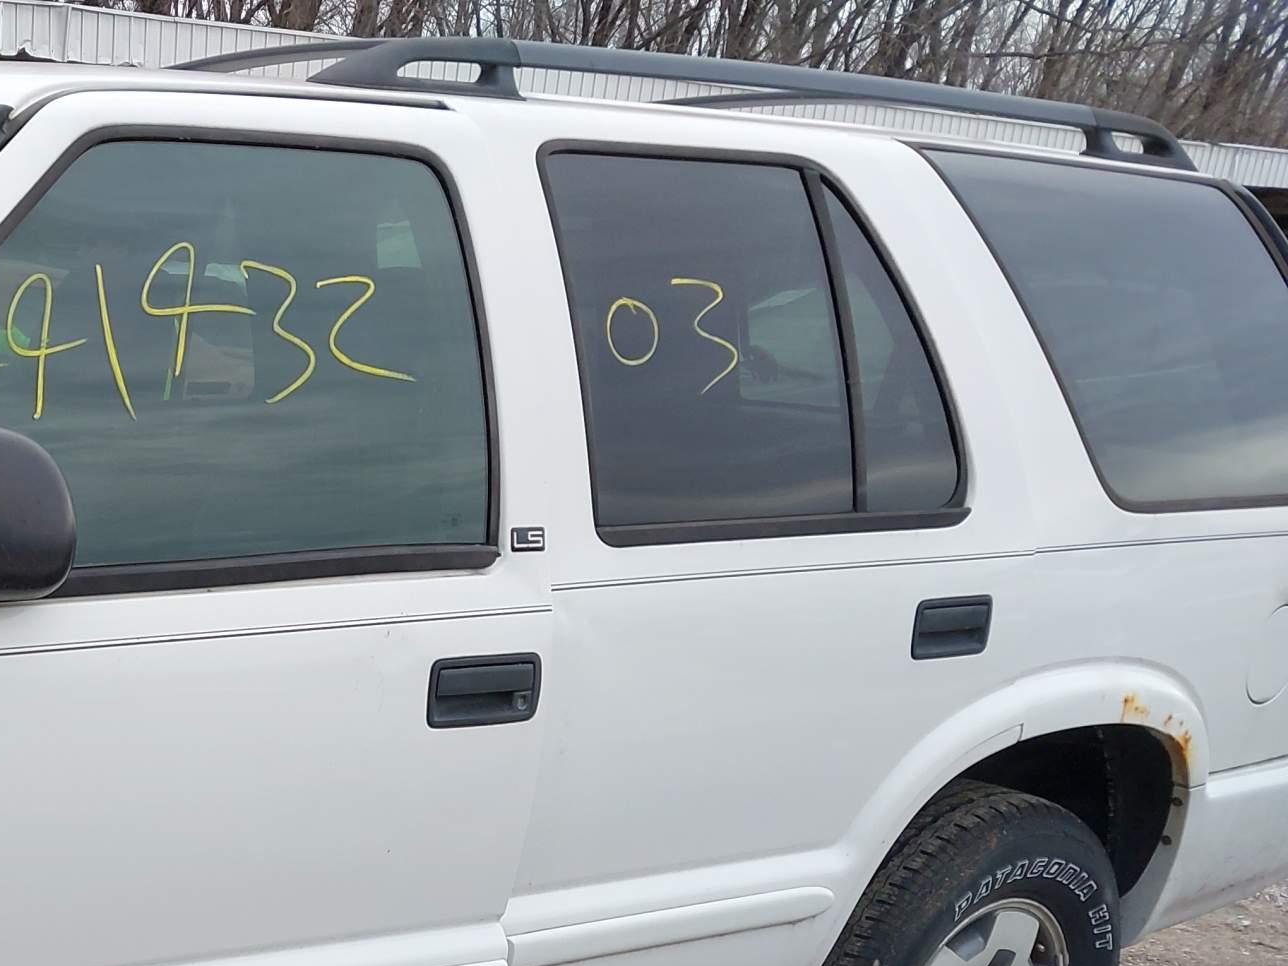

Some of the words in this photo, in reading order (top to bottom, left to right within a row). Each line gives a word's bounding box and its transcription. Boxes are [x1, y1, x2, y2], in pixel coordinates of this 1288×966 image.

[606, 278, 739, 394] 03
[513, 530, 544, 548] LS
[954, 857, 1097, 921] PATAGONIA
